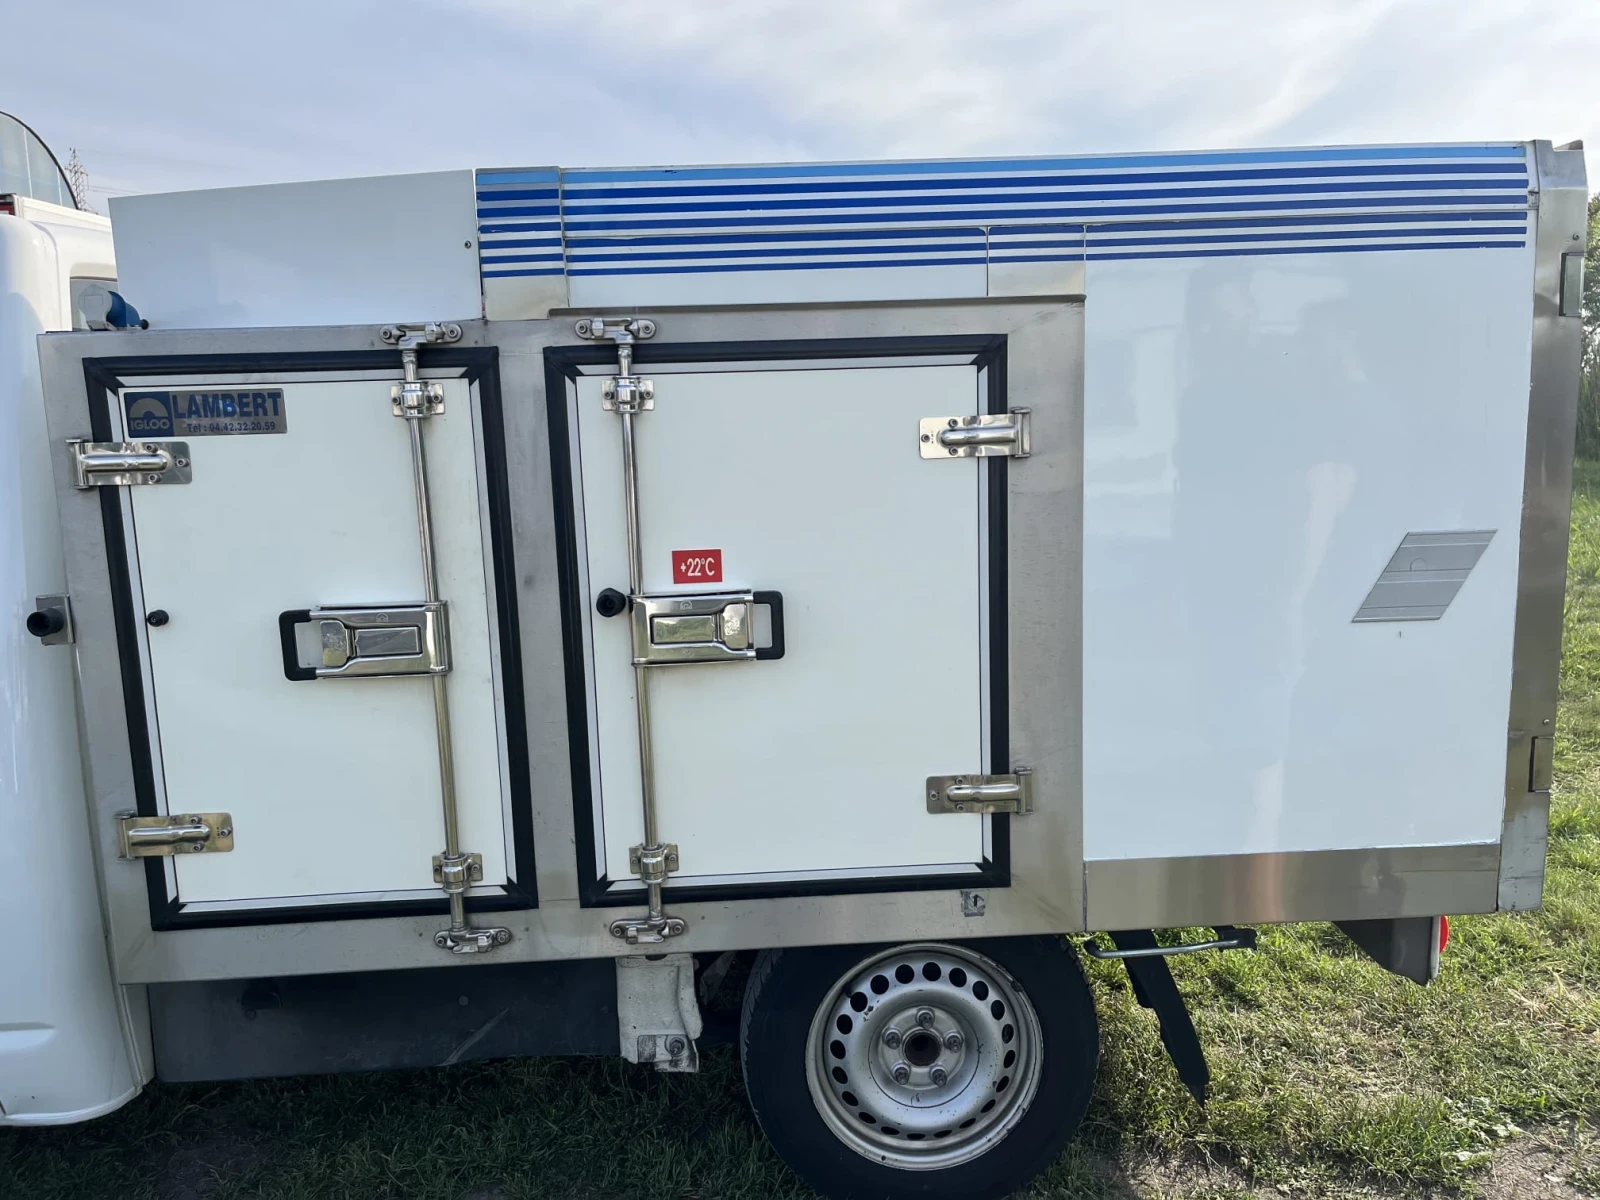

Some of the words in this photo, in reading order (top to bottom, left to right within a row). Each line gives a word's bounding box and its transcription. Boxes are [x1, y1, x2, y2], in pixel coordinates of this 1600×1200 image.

[172, 392, 281, 419] LAMBERT
[131, 418, 170, 430] IGLOO
[209, 421, 276, 433] 04.42.32.20.59
[680, 557, 715, 577] +22°C
